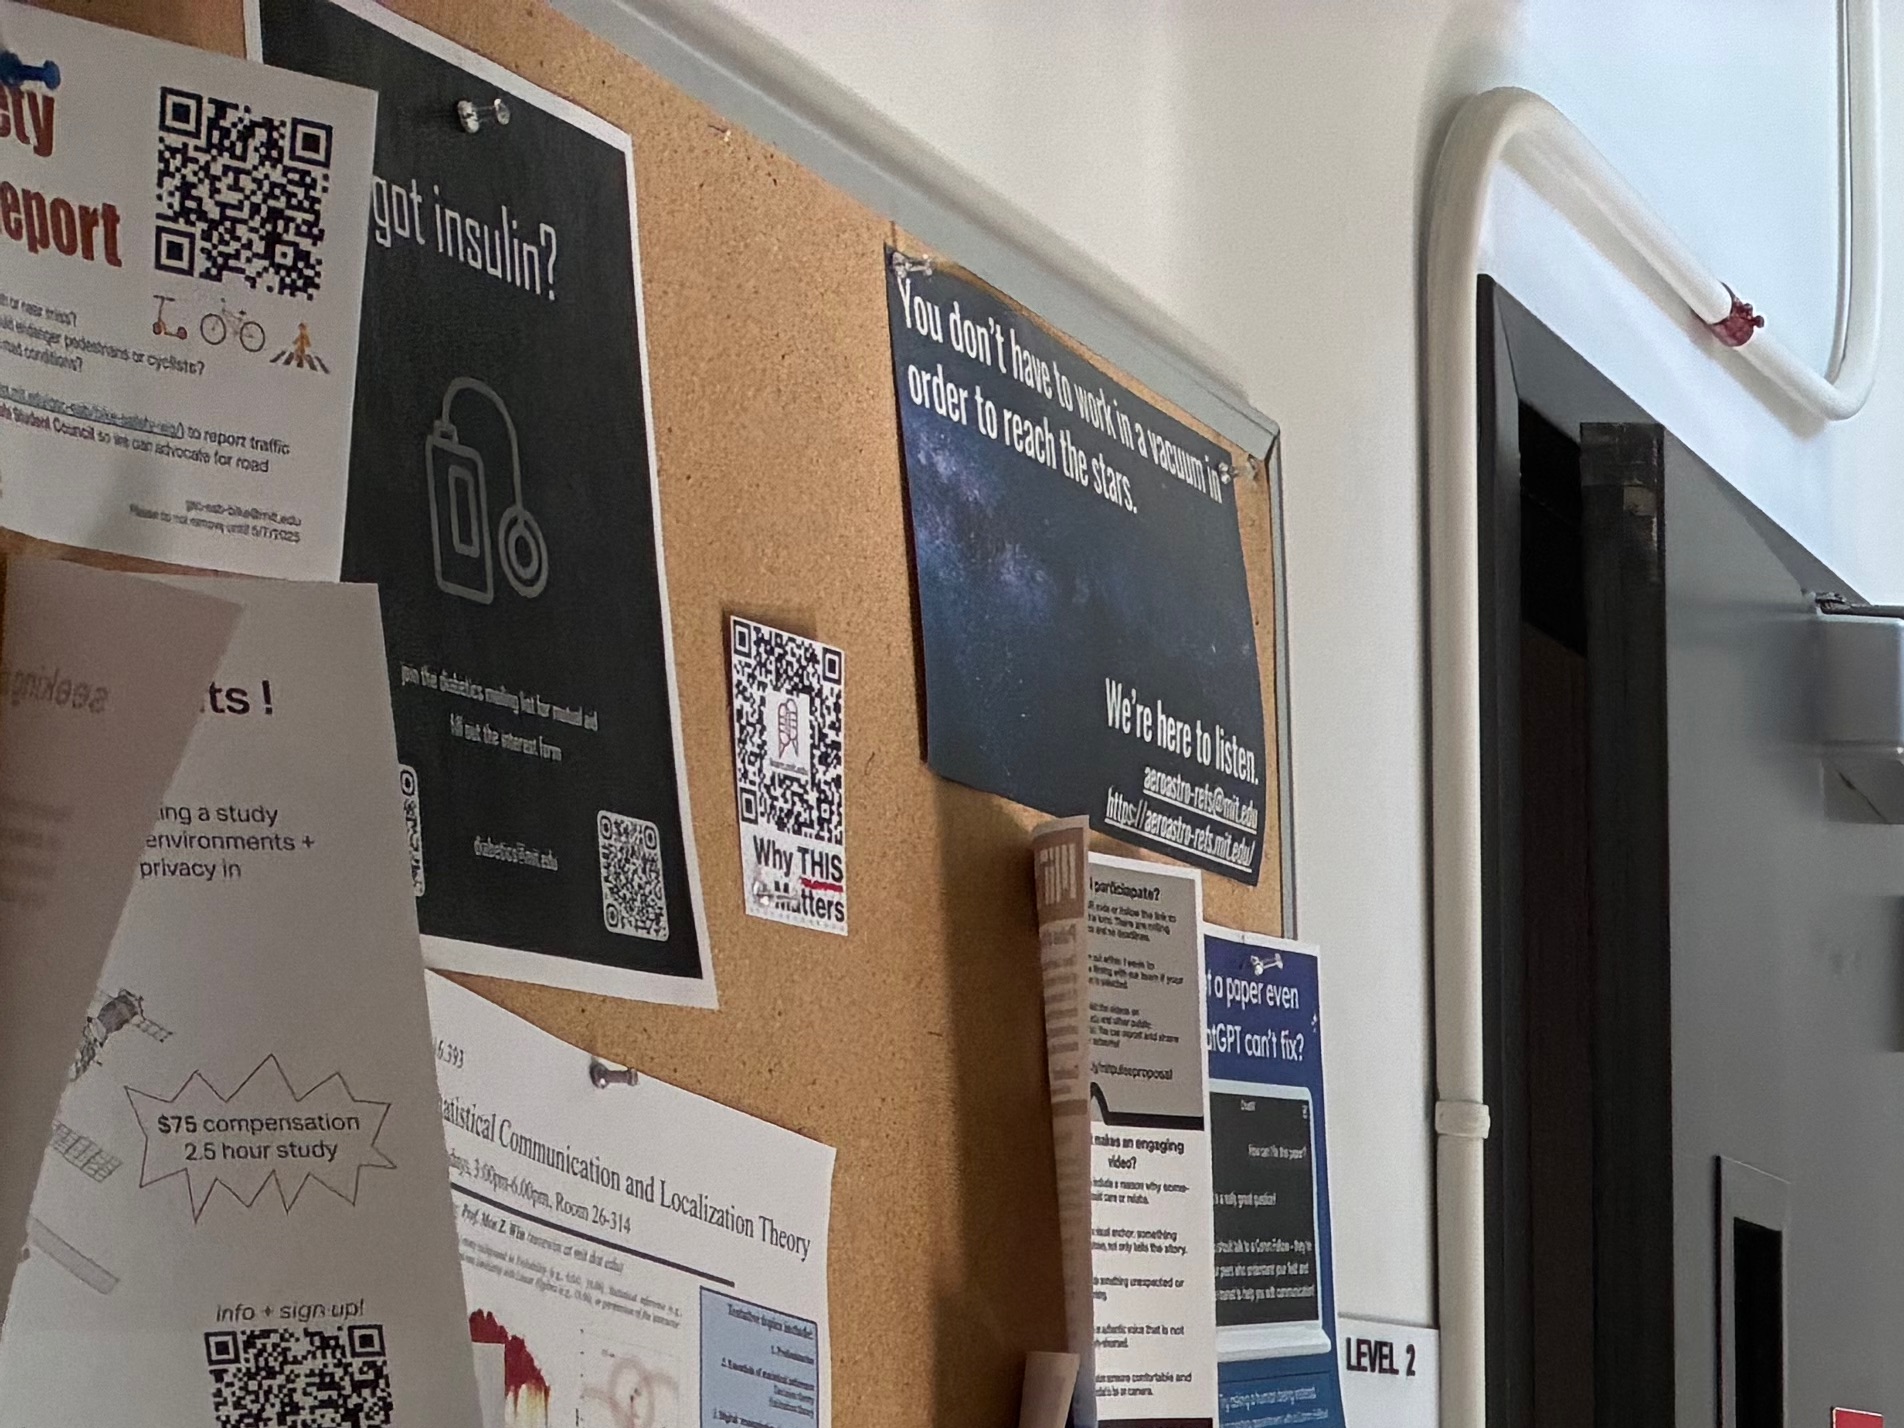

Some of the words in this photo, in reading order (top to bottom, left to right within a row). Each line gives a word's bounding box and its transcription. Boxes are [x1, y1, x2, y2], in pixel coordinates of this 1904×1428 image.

[371, 175, 425, 248] got
[433, 185, 558, 301] insulin?
[897, 277, 944, 343] You
[949, 301, 1007, 374] don't
[1011, 329, 1052, 399] have
[1053, 360, 1074, 412] to
[1074, 384, 1117, 440] work
[1113, 399, 1134, 450] in
[1135, 423, 1148, 458] a
[1147, 430, 1206, 493] vacuum
[1205, 455, 1222, 504] in
[908, 364, 968, 425] order
[974, 385, 998, 439] to
[1003, 407, 1057, 470] reach
[1059, 430, 1089, 487] the
[1091, 453, 1138, 514] stars.
[1105, 677, 1152, 742] We're
[1157, 700, 1191, 758] here
[1196, 720, 1211, 765] to
[1215, 725, 1259, 785] listen.
[198, 807, 210, 821] a
[216, 805, 278, 827] study
[146, 830, 296, 851] environments
[140, 858, 216, 881] privacy
[223, 858, 241, 878] in
[753, 835, 794, 878] Why
[797, 846, 844, 883] THIS
[1214, 976, 1223, 998] a
[1226, 977, 1264, 1010] paper
[1266, 984, 1299, 1009] even
[1245, 1028, 1276, 1058] can't
[1281, 1029, 1304, 1061] fix?
[157, 1114, 198, 1135] $75
[202, 1113, 361, 1135] compensation
[184, 1142, 216, 1161] 2.5
[222, 1142, 271, 1160] hour
[277, 1140, 338, 1162] study
[499, 1118, 620, 1192] Communication
[625, 1172, 654, 1202] and
[659, 1179, 754, 1237] Localization
[759, 1215, 811, 1262] Theory
[592, 1204, 631, 1234] 26-314
[216, 1303, 255, 1322] info
[1346, 1337, 1399, 1375] LEVEL
[1406, 1344, 1416, 1377] 2
